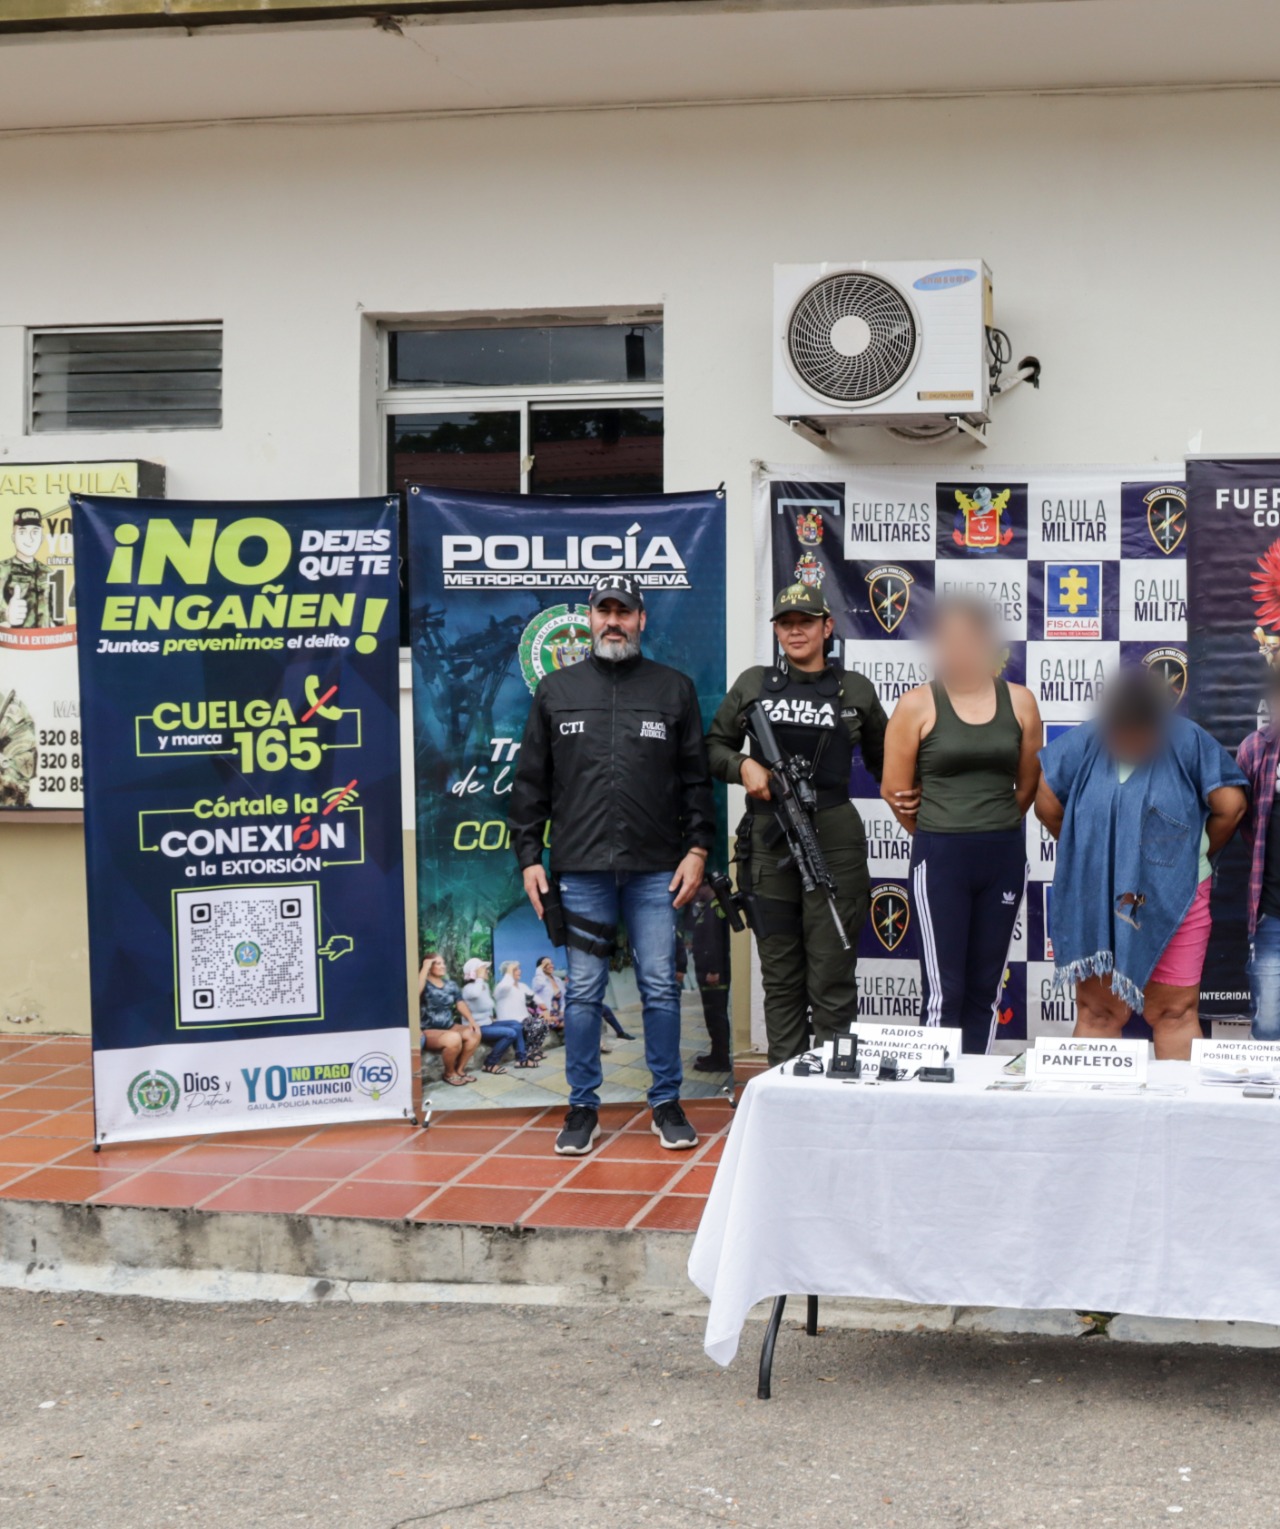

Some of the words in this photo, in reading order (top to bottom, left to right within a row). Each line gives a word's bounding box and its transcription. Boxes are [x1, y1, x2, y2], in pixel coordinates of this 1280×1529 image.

[46, 472, 132, 494] HUILA
[852, 502, 930, 522] FUERZAS
[1041, 499, 1107, 522] GAULA
[851, 522, 930, 542] MILITARES
[1041, 521, 1107, 542] MILITAR
[106, 517, 292, 585] ¡NO
[300, 529, 391, 553] DEJES
[441, 521, 687, 571] POLICÍA
[299, 555, 355, 581] QUE
[357, 554, 391, 576] TE
[444, 573, 599, 587] METROPOLITANA
[633, 573, 689, 586] NEIVA
[596, 574, 633, 595] CTI
[1134, 579, 1185, 601] GAUL
[1134, 601, 1187, 622] MILITA
[1047, 618, 1099, 629] FISCALÍA
[20, 634, 29, 645] LA
[31, 632, 72, 646] EXTORSIÓN
[97, 638, 160, 654] Juntos
[162, 634, 284, 656] prevenimos
[287, 635, 302, 649] el
[304, 633, 350, 649] delito
[1040, 659, 1105, 681] GAULA
[152, 699, 296, 731] CUELGA
[761, 698, 835, 716] GAULA
[559, 720, 585, 736] CTI
[767, 709, 835, 727] OLICIA
[39, 730, 66, 746] 320
[157, 734, 168, 750] y
[171, 733, 223, 746] marca
[234, 728, 322, 773] 165
[40, 753, 67, 769] 320
[39, 777, 66, 792] 320
[452, 766, 485, 797] de
[194, 794, 288, 819] Córtale
[295, 793, 318, 814] la
[160, 816, 345, 858] CONEXIÓN
[185, 865, 197, 877] a
[200, 861, 217, 876] la
[221, 854, 321, 876] EXTORSIÓN
[856, 976, 923, 997] FUERZA
[1200, 991, 1250, 1001] INTEGRIDA
[881, 1028, 924, 1038] RADIOS
[857, 1048, 923, 1060] RGADORES
[1059, 1043, 1118, 1052] AGENDA
[1203, 1052, 1248, 1061] POSIBLES
[1216, 1042, 1280, 1052] ANOTACIONES
[1042, 1054, 1133, 1068] PANFLETOS
[183, 1072, 220, 1093] Dios
[225, 1080, 232, 1092] y
[241, 1065, 287, 1103] YO
[291, 1067, 311, 1081] NO
[314, 1064, 349, 1080] PAGO
[358, 1065, 392, 1083] 165
[291, 1081, 351, 1097] DENUNCIO
[184, 1091, 232, 1112] Patria
[247, 1101, 275, 1111] GAULA
[277, 1098, 310, 1109] POLICÍA
[312, 1095, 354, 1106] NACIONAL
